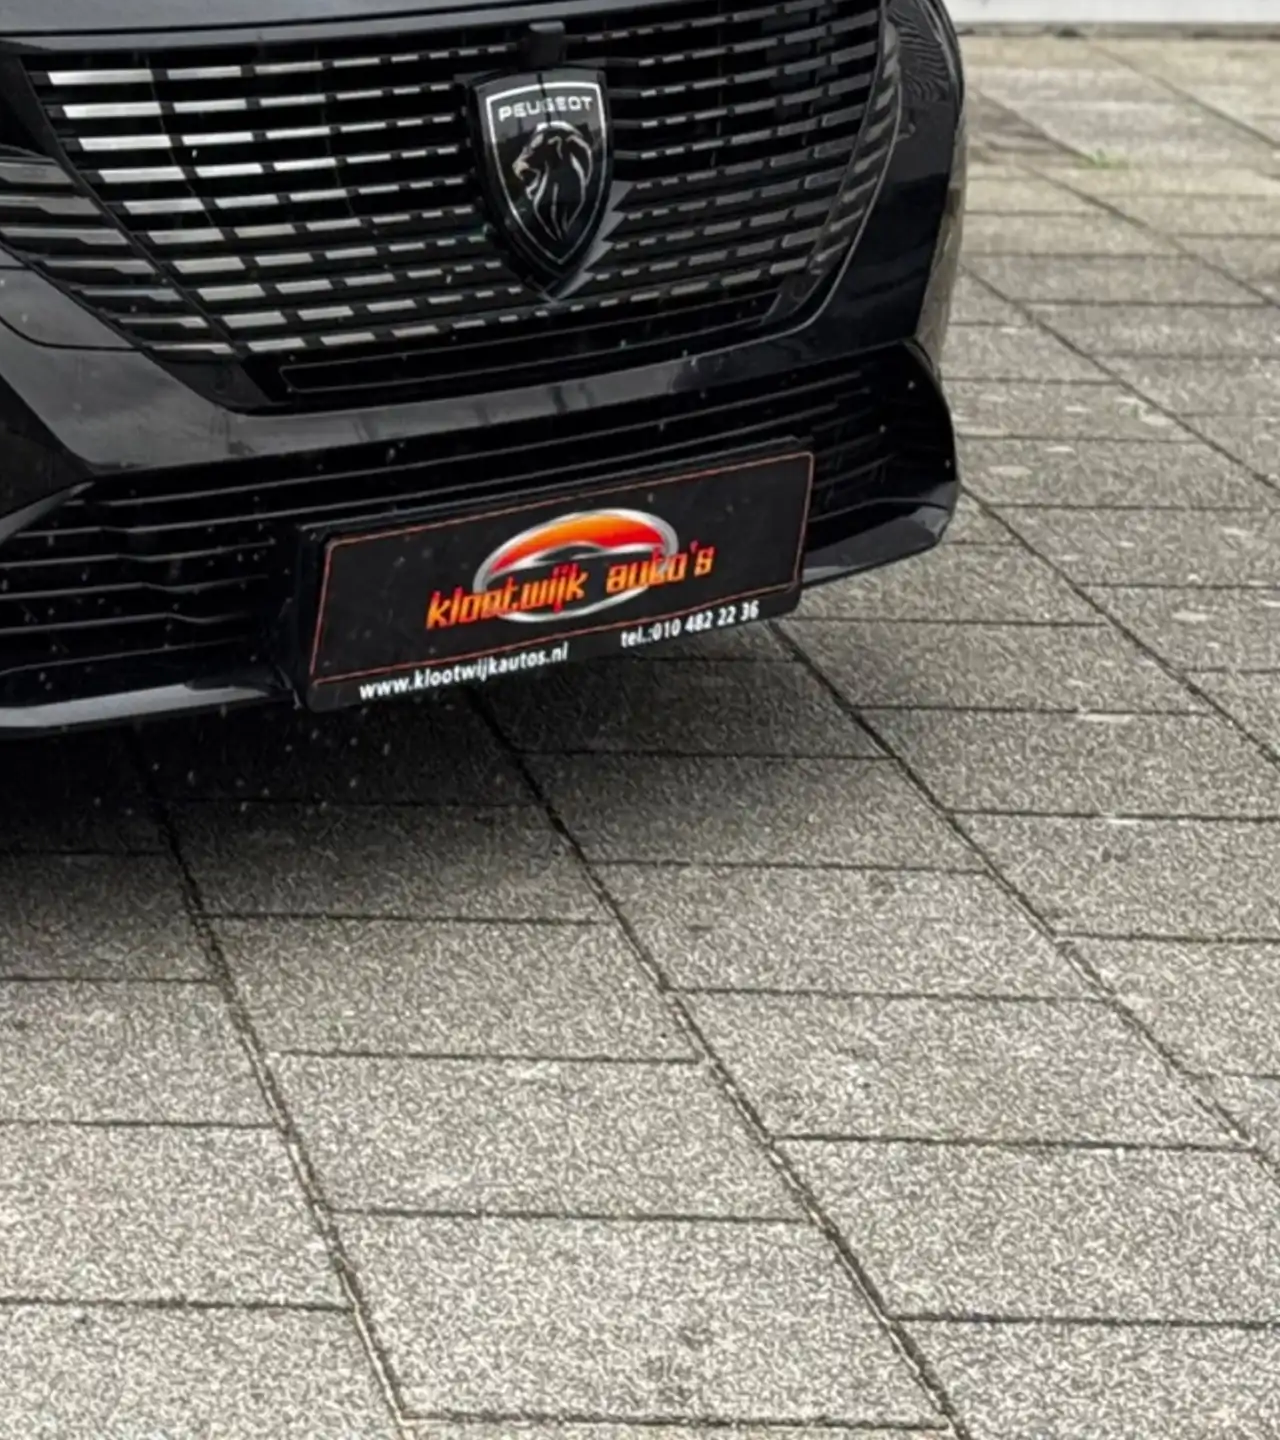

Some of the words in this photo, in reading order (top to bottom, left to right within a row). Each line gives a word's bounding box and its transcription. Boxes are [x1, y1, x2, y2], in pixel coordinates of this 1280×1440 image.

[498, 95, 593, 122] PEUGEOT
[425, 562, 589, 630] klootwijk
[605, 540, 715, 594] auto's
[685, 611, 713, 633] 482
[717, 605, 737, 627] 22
[740, 600, 760, 621] 36
[359, 642, 570, 701] www.klootwijkautos.nl
